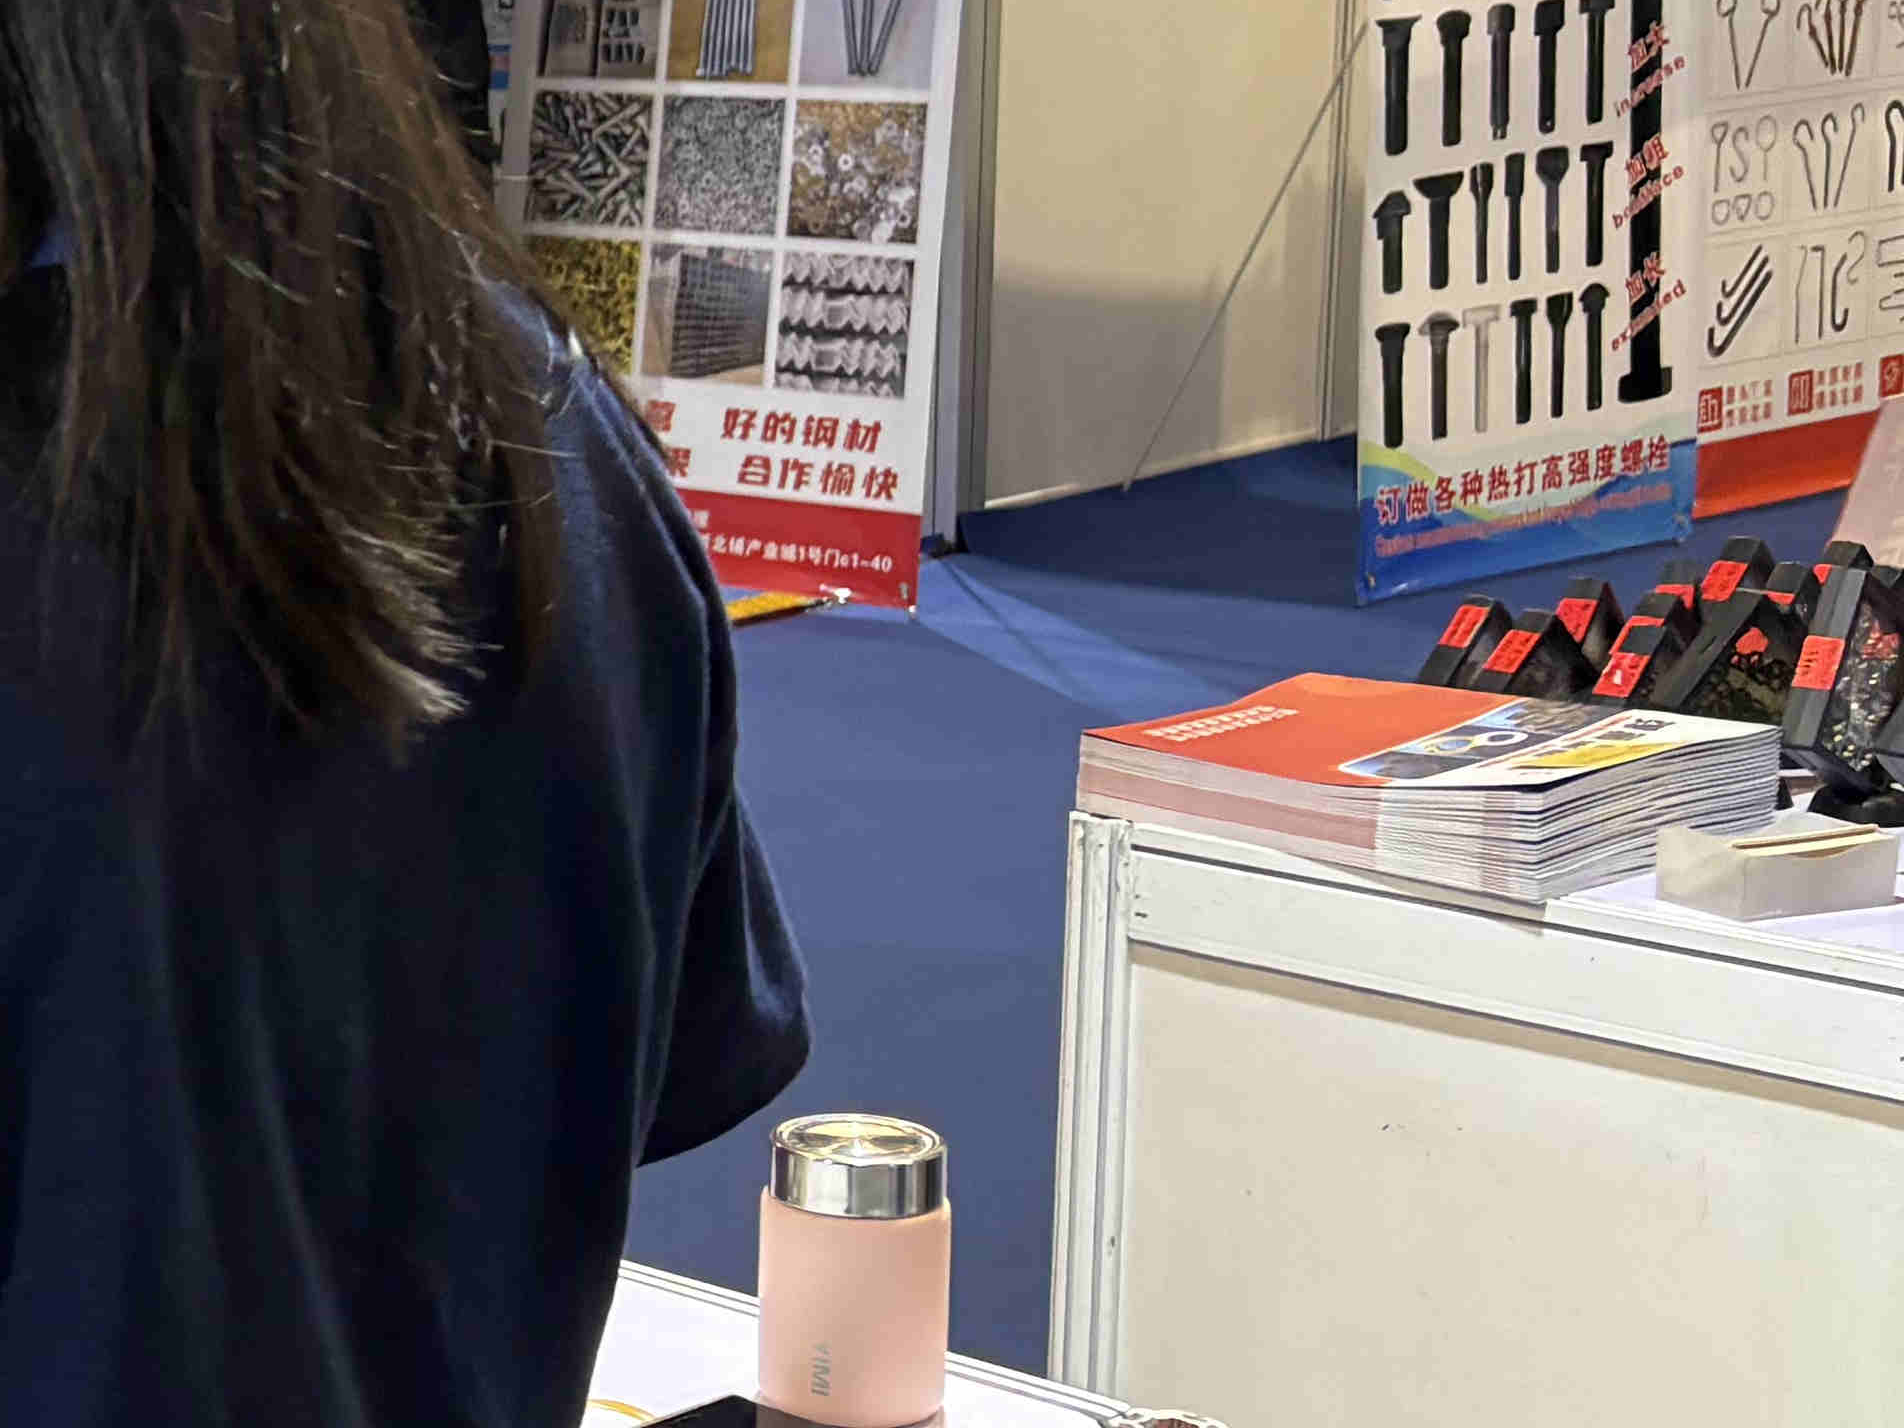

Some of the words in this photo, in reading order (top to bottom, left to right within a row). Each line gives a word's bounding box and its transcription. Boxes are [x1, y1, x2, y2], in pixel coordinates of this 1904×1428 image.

[722, 407, 882, 454] 好的钢材
[737, 454, 899, 503] 合作愉快
[1376, 434, 1672, 525] 订做各种热打高强度螺栓
